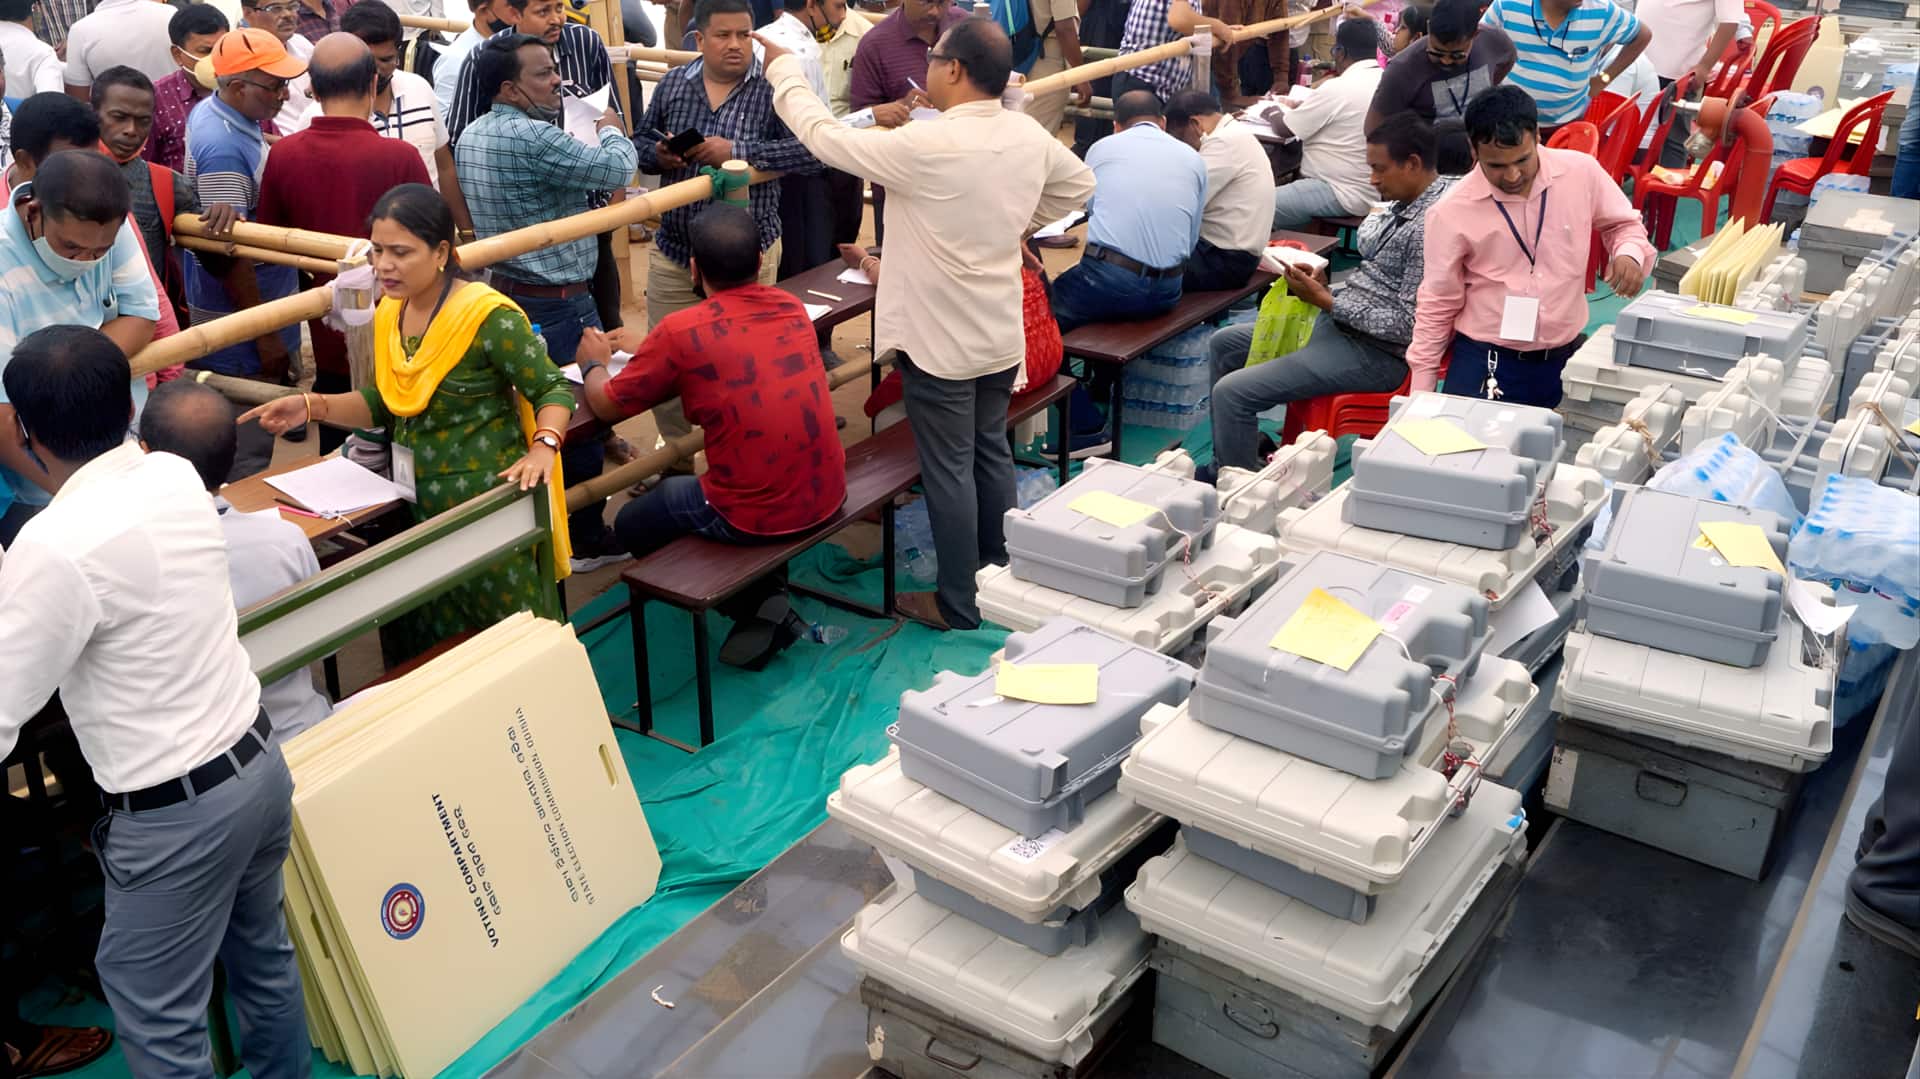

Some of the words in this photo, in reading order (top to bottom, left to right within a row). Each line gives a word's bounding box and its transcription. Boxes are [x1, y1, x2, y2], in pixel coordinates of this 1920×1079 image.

[432, 793, 477, 894] COMPARTMENT
[560, 823, 581, 872] ELECTION
[474, 897, 499, 948] VOTING
